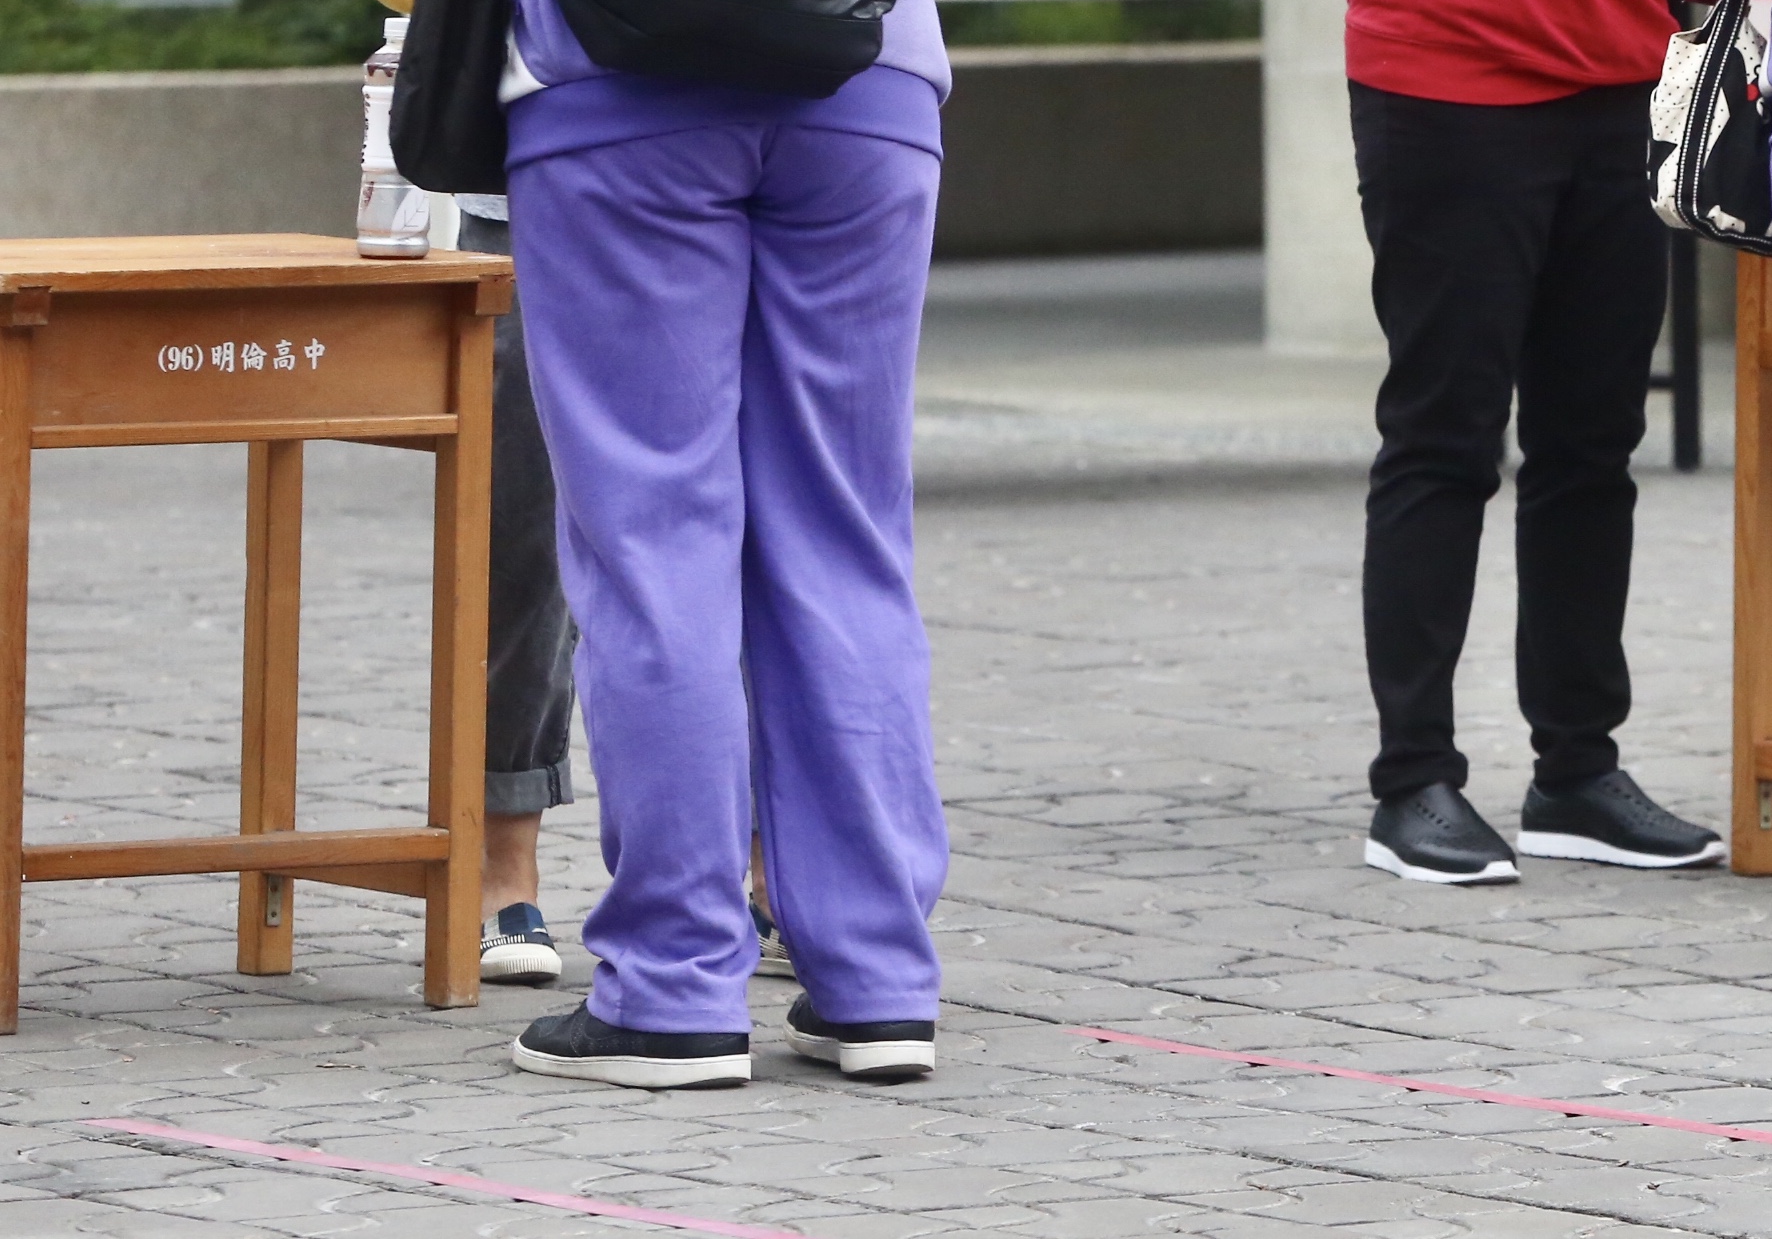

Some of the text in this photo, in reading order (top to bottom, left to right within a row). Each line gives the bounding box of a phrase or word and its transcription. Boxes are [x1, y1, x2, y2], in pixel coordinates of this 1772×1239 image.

[157, 337, 327, 373] (96) 明倫高中
